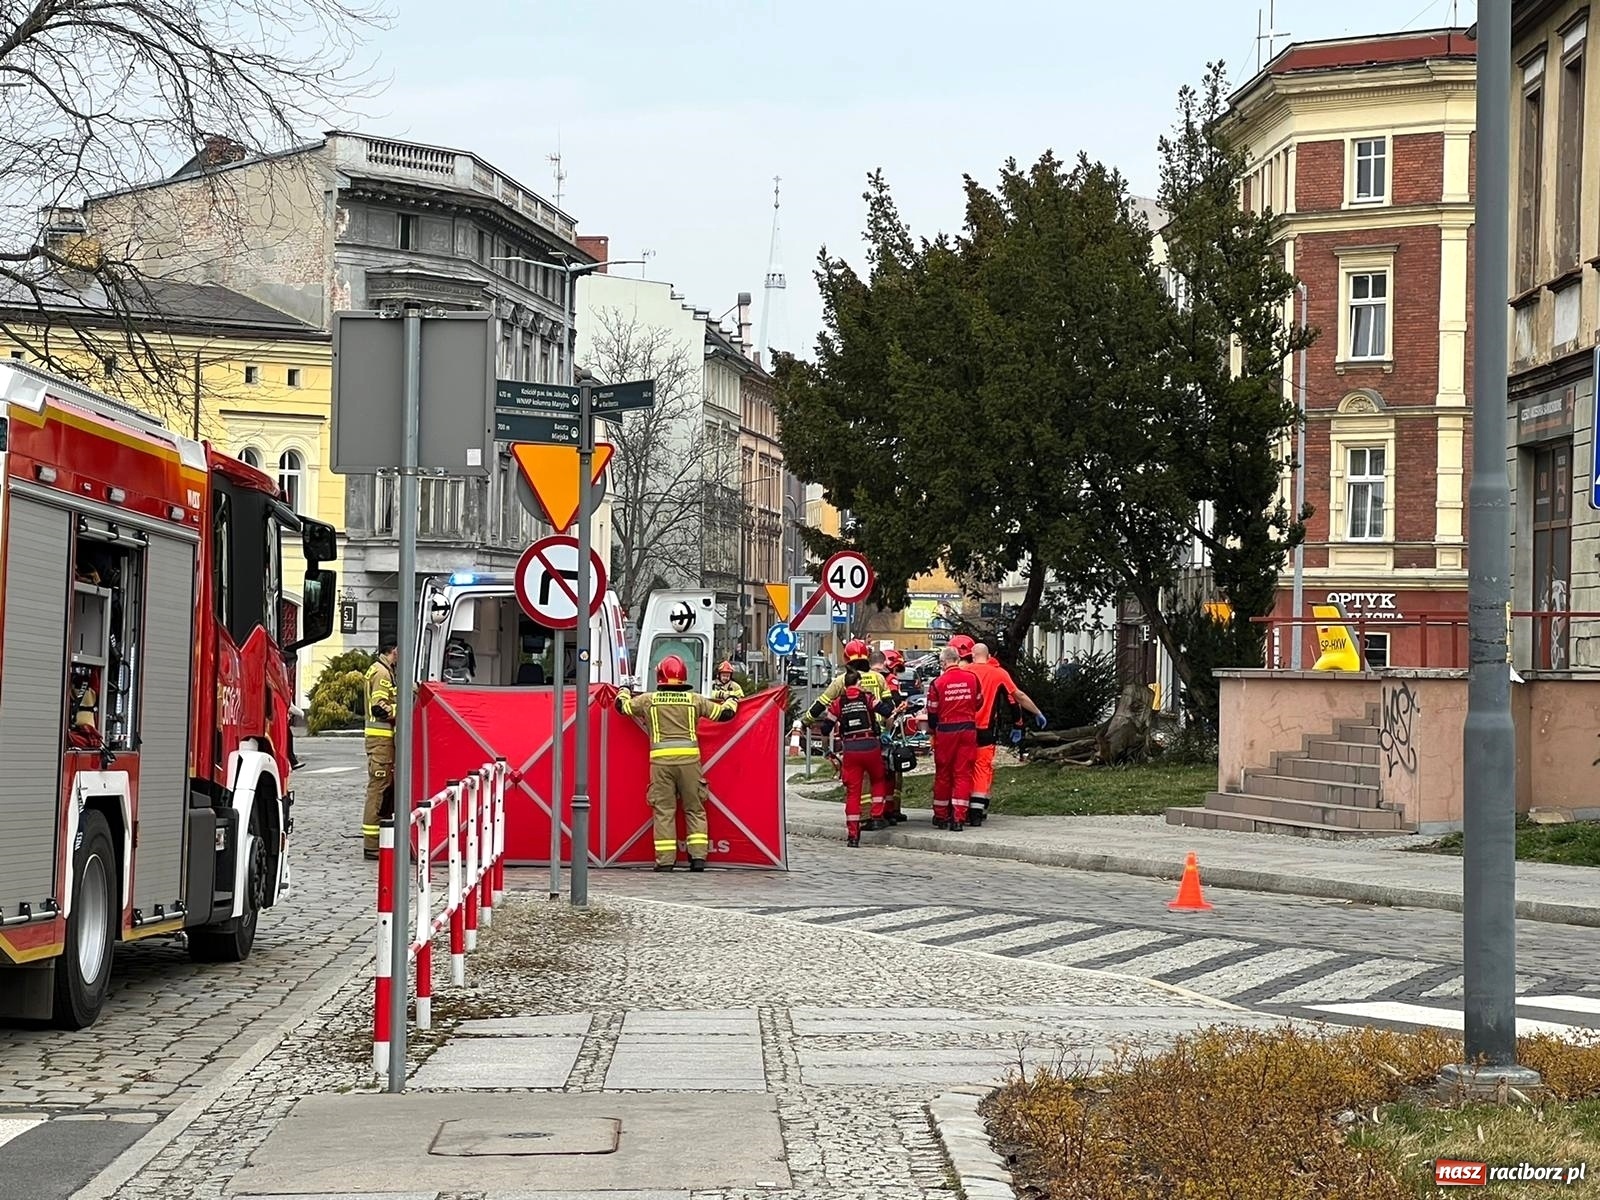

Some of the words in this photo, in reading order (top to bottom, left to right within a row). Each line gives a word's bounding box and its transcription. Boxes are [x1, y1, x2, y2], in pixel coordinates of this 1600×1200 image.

[830, 564, 866, 589] 40
[1326, 592, 1396, 609] OPTYK
[1321, 637, 1347, 652] SP-HXW
